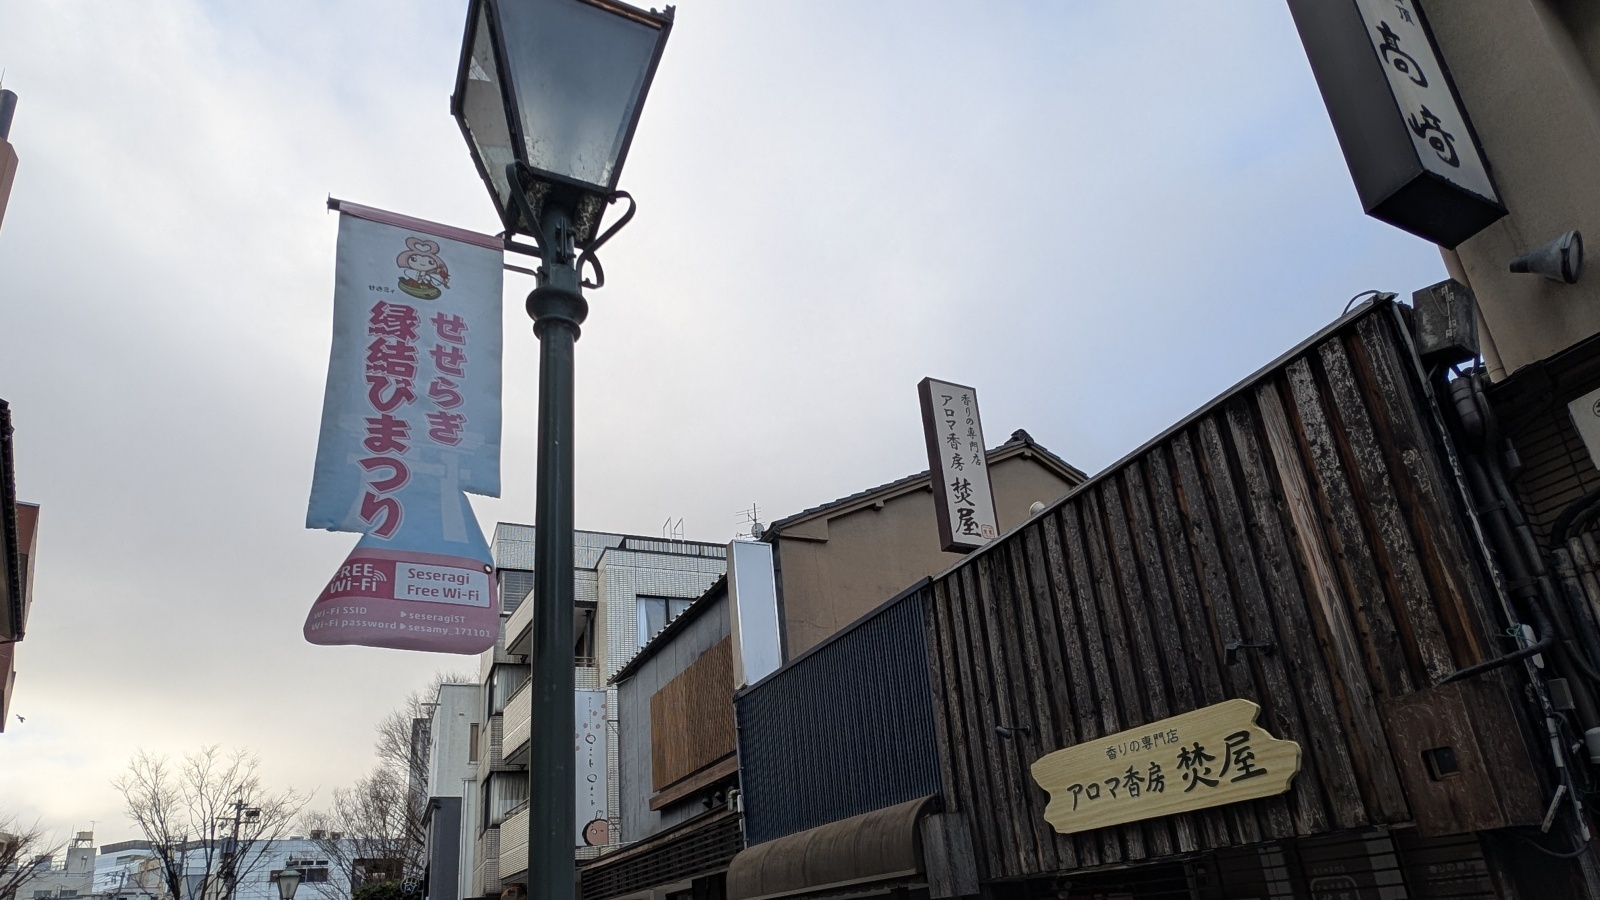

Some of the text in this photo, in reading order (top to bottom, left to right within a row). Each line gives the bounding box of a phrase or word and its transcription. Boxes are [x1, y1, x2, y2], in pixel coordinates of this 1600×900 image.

[426, 312, 469, 446] せせらぎ
[357, 300, 421, 541] 縁結びまつり
[960, 393, 982, 466] 香りの専門店
[941, 394, 982, 538] アロマ香房 焚屋
[332, 563, 374, 581] FREE
[407, 568, 470, 586] Seseragi
[330, 577, 377, 594] Wi-Fi
[407, 584, 480, 601] Free Wi-Fi
[313, 606, 466, 624] Wi-Fi SSID seseragiST
[311, 619, 491, 638] Wi-Fi password sesamy_171101
[1105, 728, 1180, 761] 香りの専門店
[1066, 729, 1268, 811] アロマ香房 焚屋
